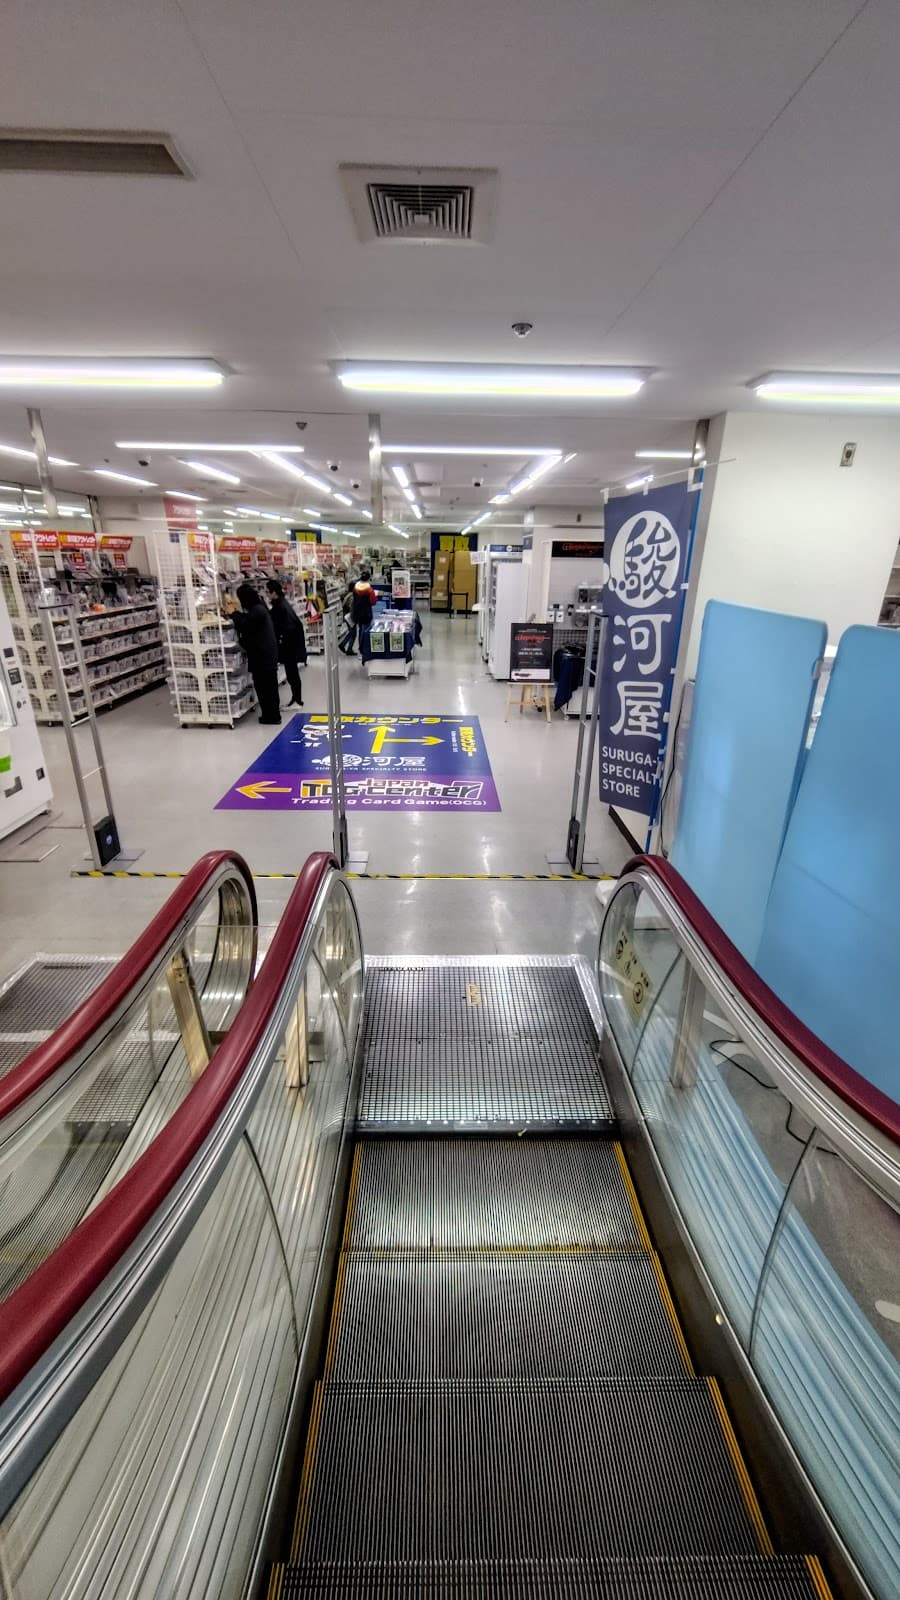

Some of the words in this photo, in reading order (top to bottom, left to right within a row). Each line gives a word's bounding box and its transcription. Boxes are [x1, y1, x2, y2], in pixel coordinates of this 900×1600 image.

[609, 515, 680, 741] 駿河屋
[602, 745, 658, 768] SURUGA-
[358, 778, 430, 787] Japan
[602, 778, 641, 799] STORE
